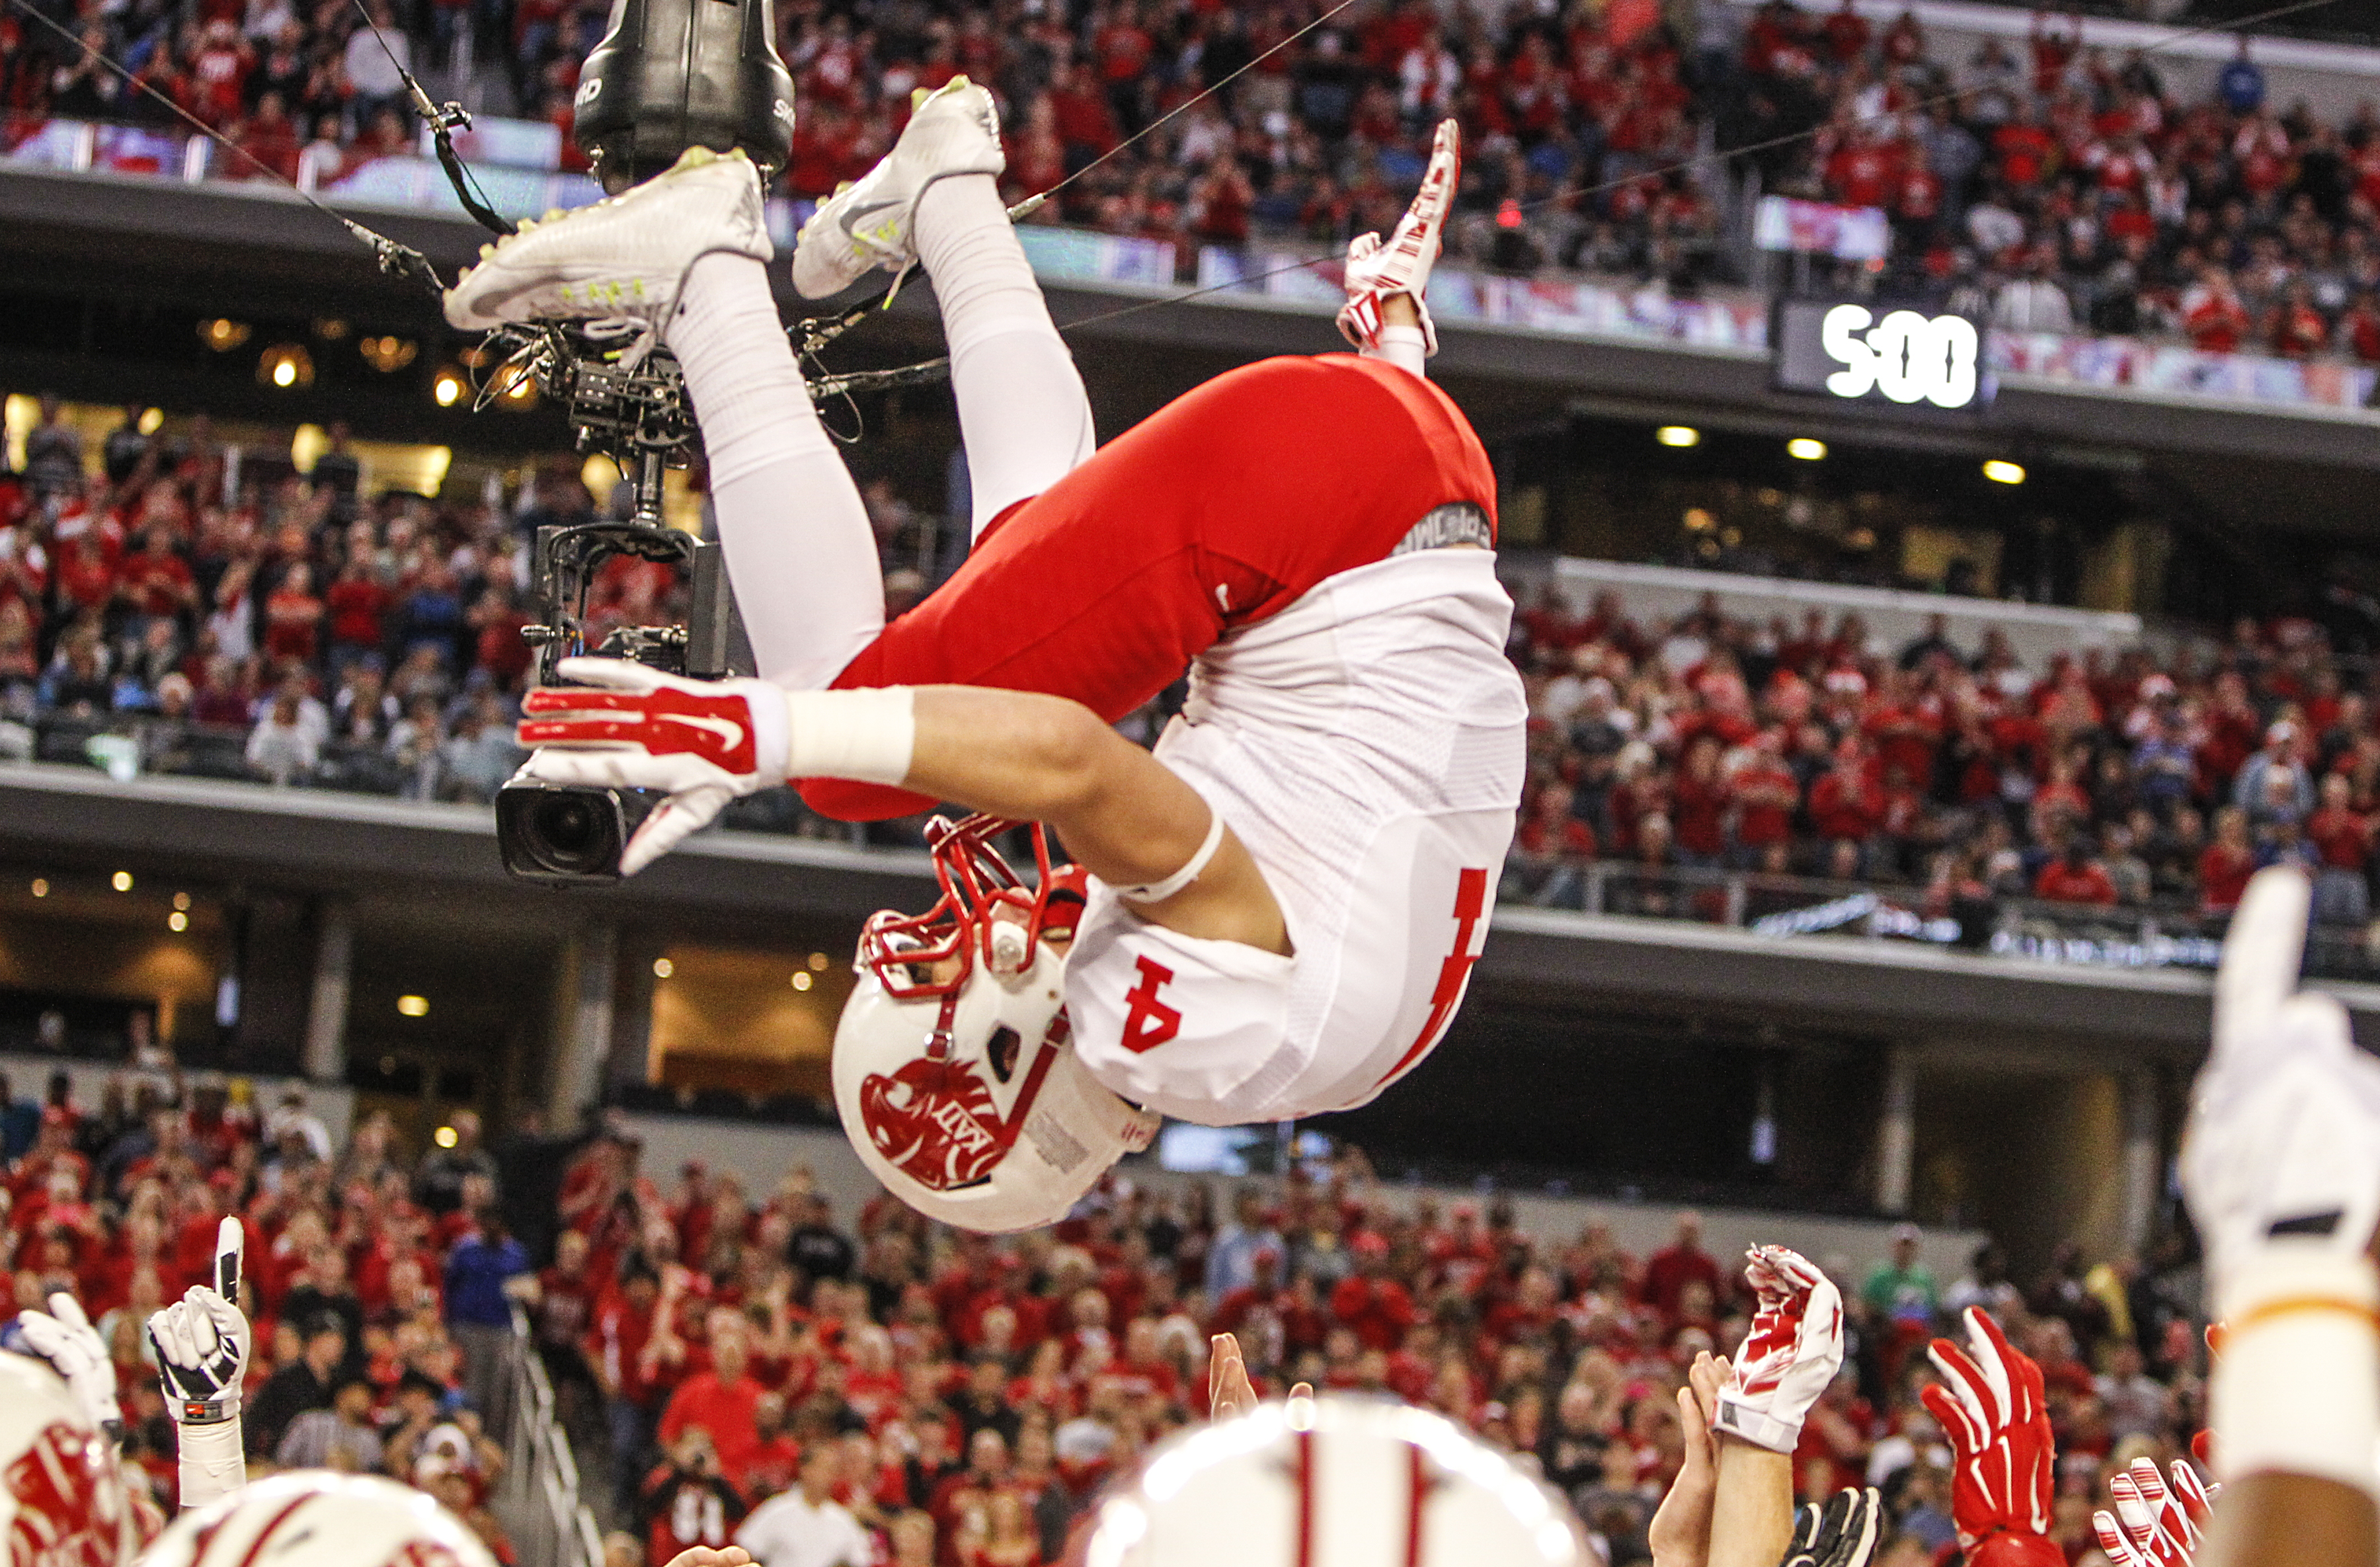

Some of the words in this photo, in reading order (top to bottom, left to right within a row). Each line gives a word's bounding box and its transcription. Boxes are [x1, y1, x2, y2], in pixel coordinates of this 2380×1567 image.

[1823, 303, 1978, 408] 5:00
[1121, 954, 1183, 1054] 4
[931, 1100, 994, 1155] KATY
